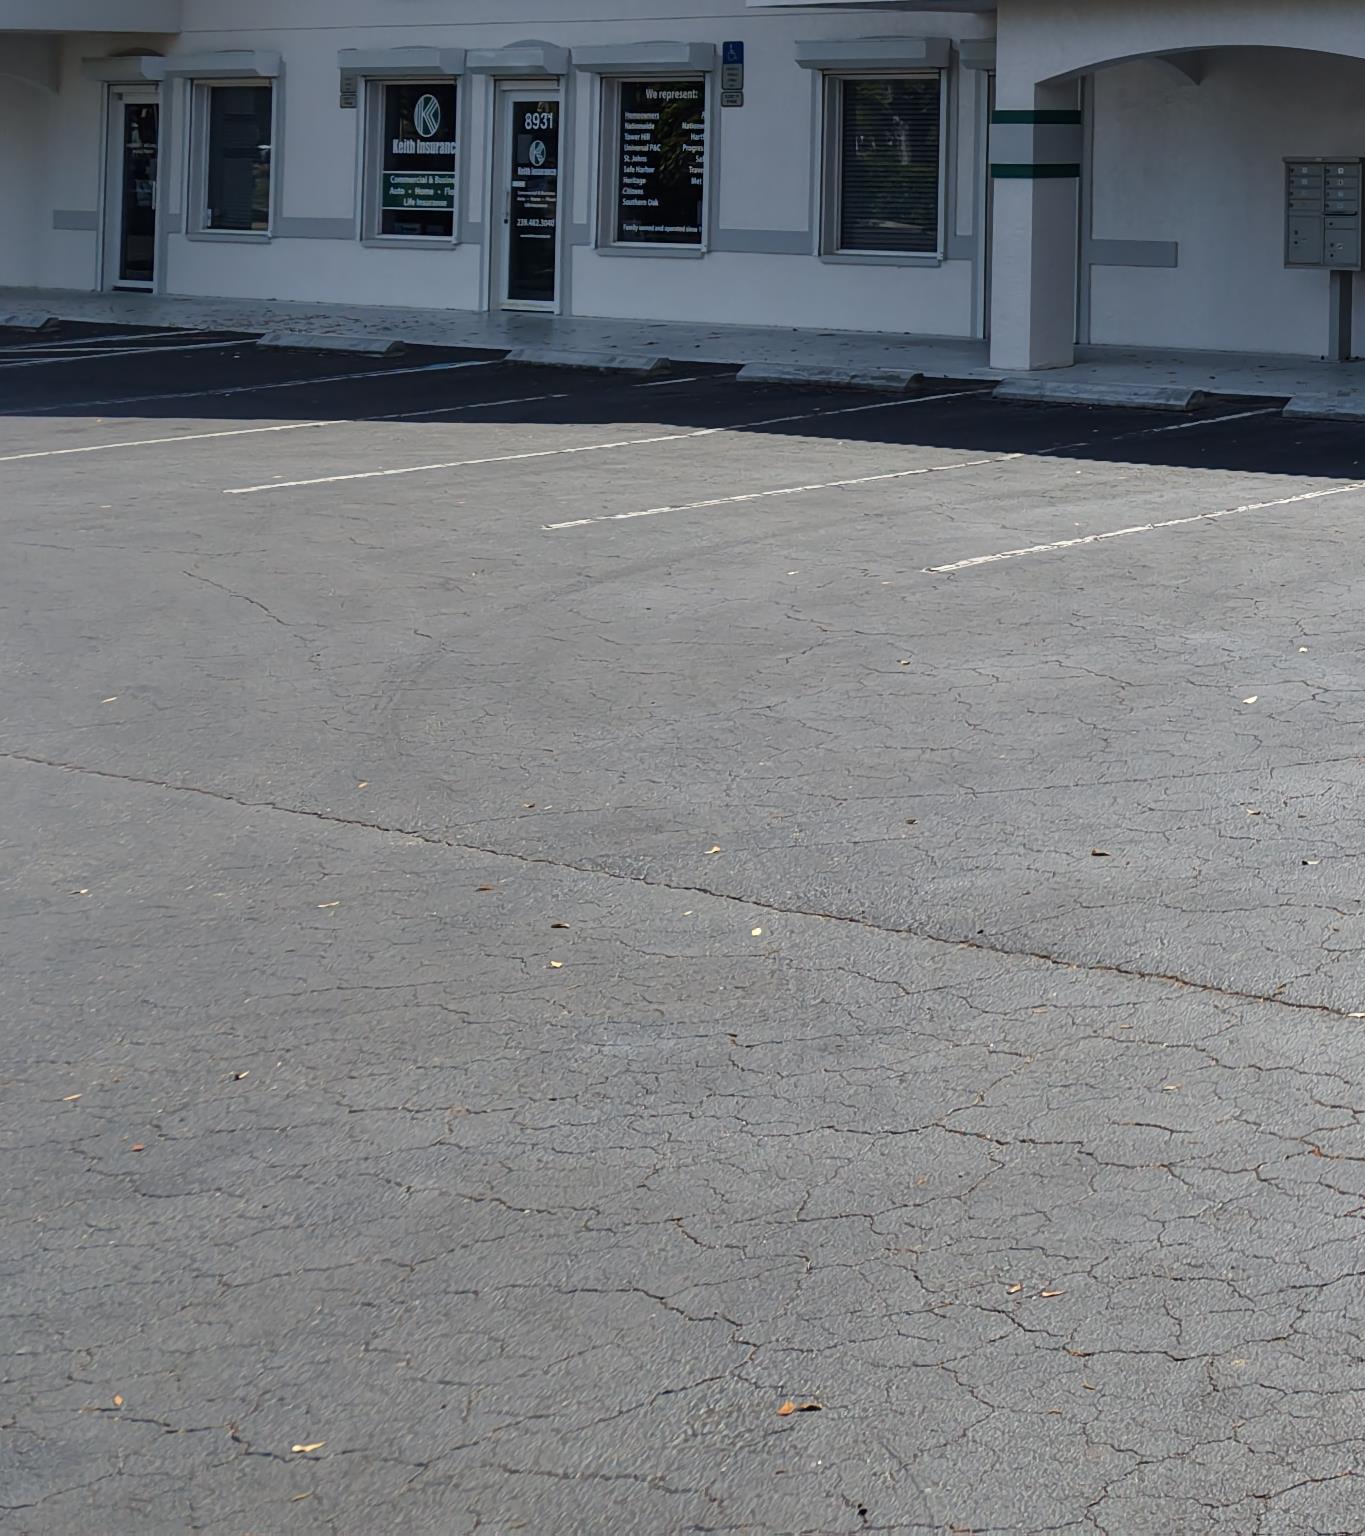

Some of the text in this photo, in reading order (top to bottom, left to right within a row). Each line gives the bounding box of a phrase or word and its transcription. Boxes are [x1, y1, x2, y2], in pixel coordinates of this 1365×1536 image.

[645, 89, 698, 101] We represent:
[524, 112, 553, 130] 8931
[392, 138, 456, 155] Keith Insuranc
